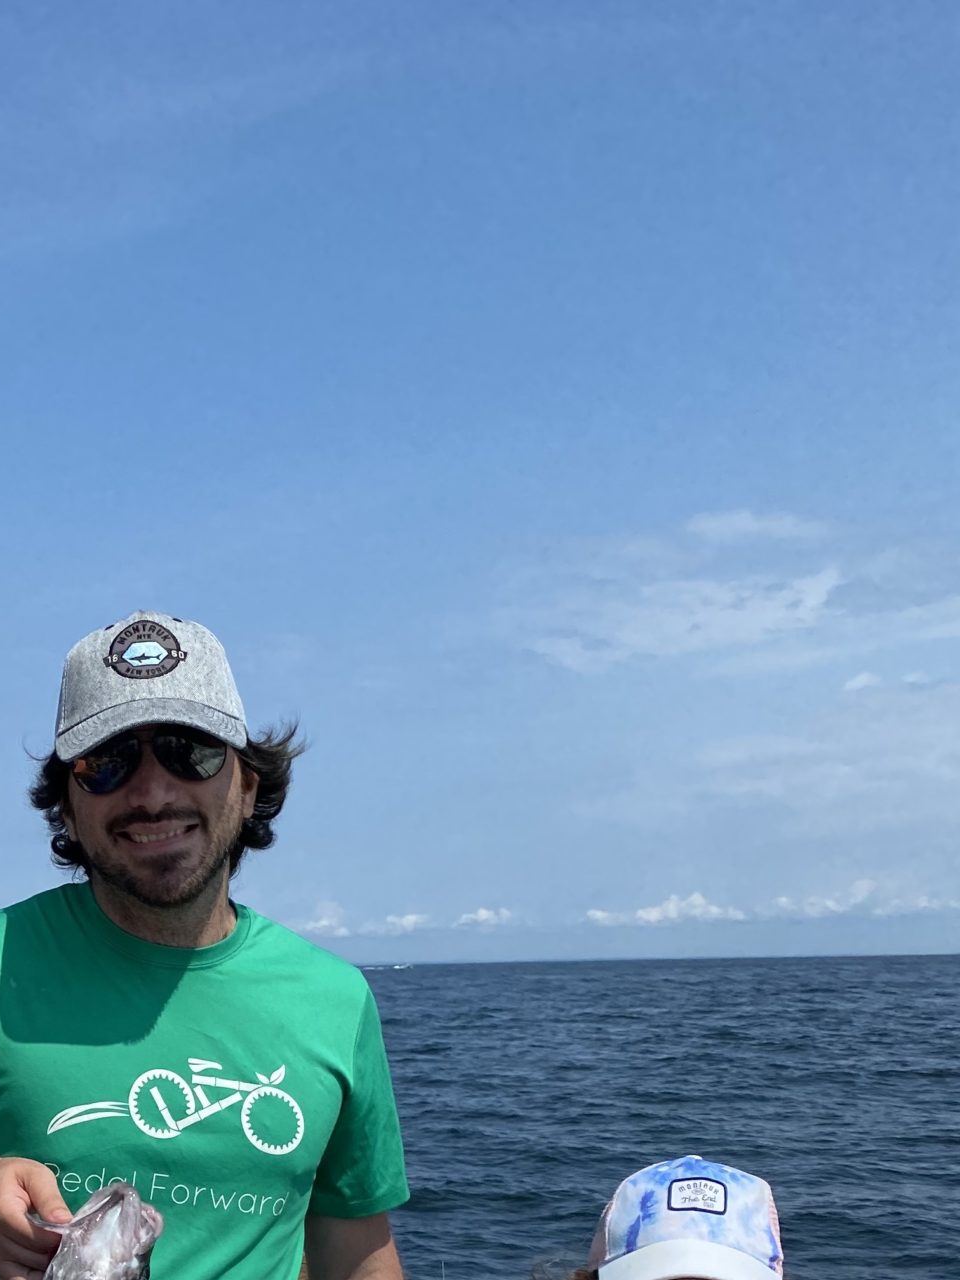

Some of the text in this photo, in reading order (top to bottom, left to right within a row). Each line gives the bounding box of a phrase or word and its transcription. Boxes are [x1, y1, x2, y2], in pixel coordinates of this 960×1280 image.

[116, 623, 171, 645] MONTAUK
[125, 664, 168, 676] NEW YORK
[149, 1172, 290, 1217] Forward
[681, 1193, 717, 1204] The End
